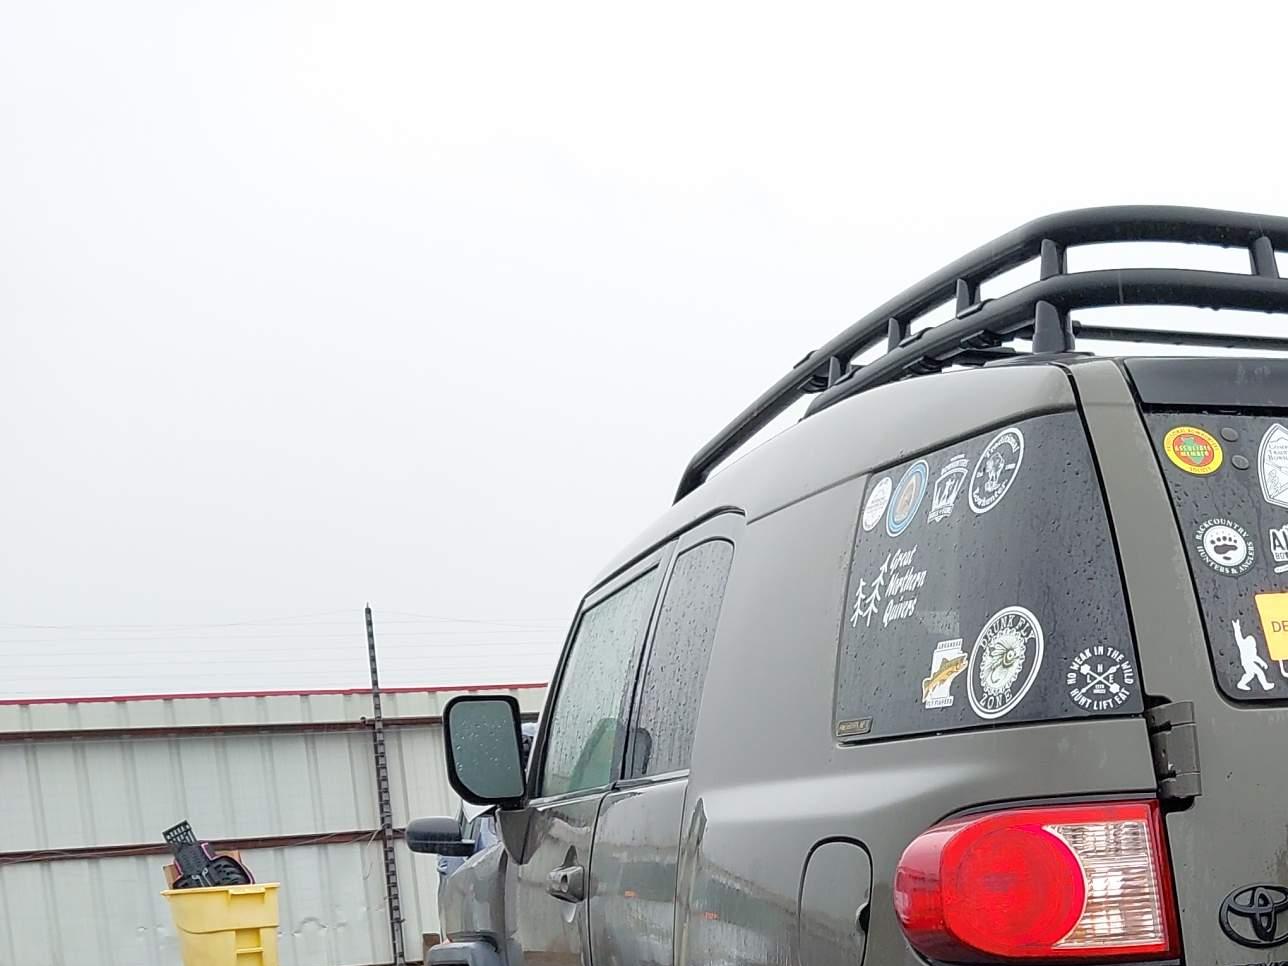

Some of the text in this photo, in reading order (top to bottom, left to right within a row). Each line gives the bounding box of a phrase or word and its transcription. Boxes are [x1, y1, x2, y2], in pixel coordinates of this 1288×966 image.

[1195, 518, 1250, 540] BACKCOUNTRY
[888, 543, 918, 576] Great
[1196, 545, 1230, 574] HUNTERS
[885, 566, 928, 598] Northern
[882, 595, 918, 628] Quivers
[980, 615, 1037, 650] DRUNK FLY
[1066, 645, 1134, 685] NO WEAK IN THE WILD
[980, 688, 1013, 711] ZONE
[1093, 698, 1114, 710] LIFT
[1113, 687, 1131, 705] EAT
